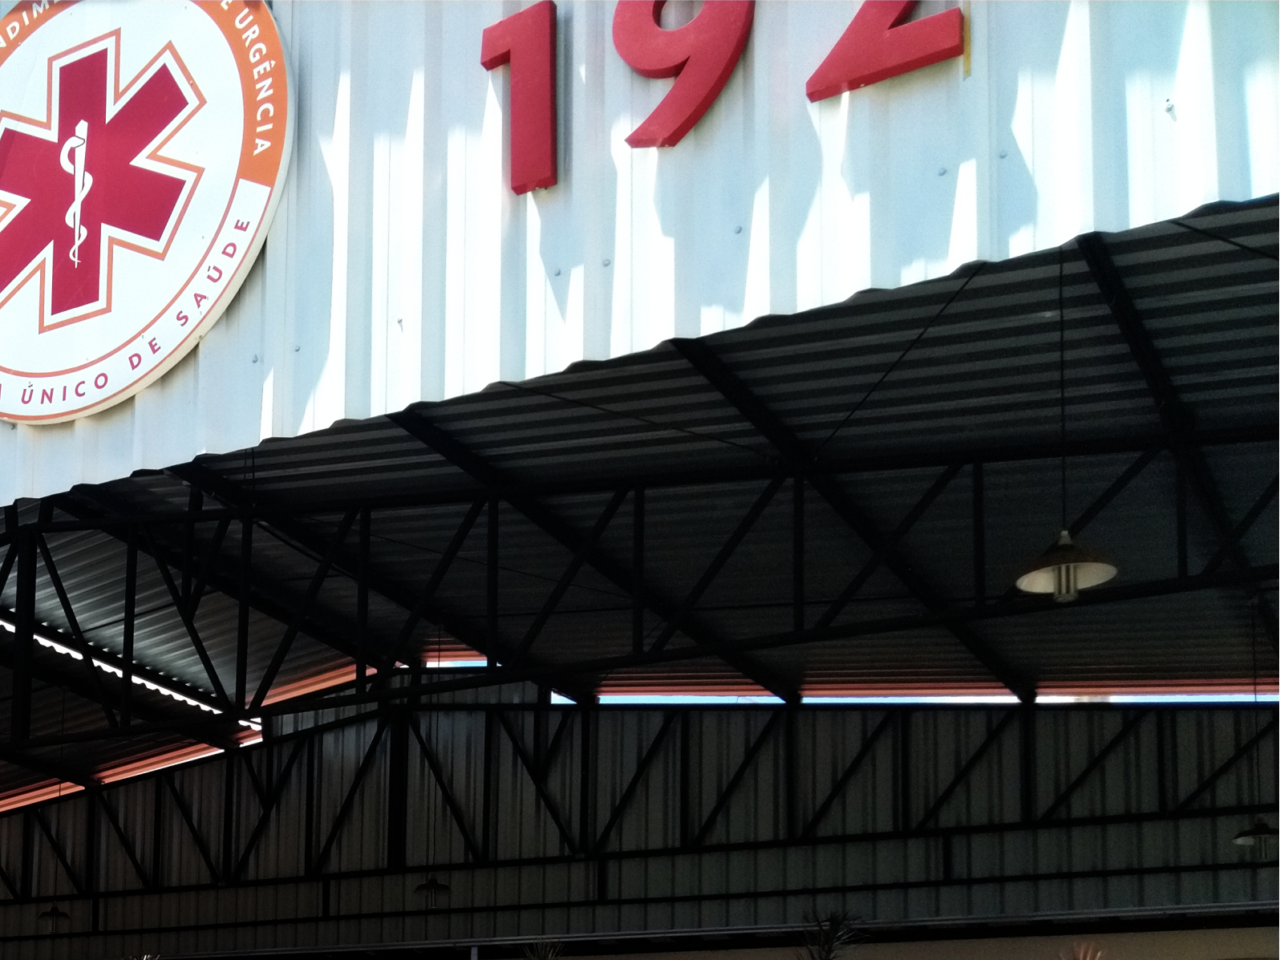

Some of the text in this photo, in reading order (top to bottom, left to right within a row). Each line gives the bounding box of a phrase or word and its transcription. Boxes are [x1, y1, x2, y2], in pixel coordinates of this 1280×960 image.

[234, 7, 275, 157] URGÊNCIA
[21, 372, 109, 405] ÚNICO
[128, 336, 162, 371] DE
[176, 218, 250, 327] SAÚDE
